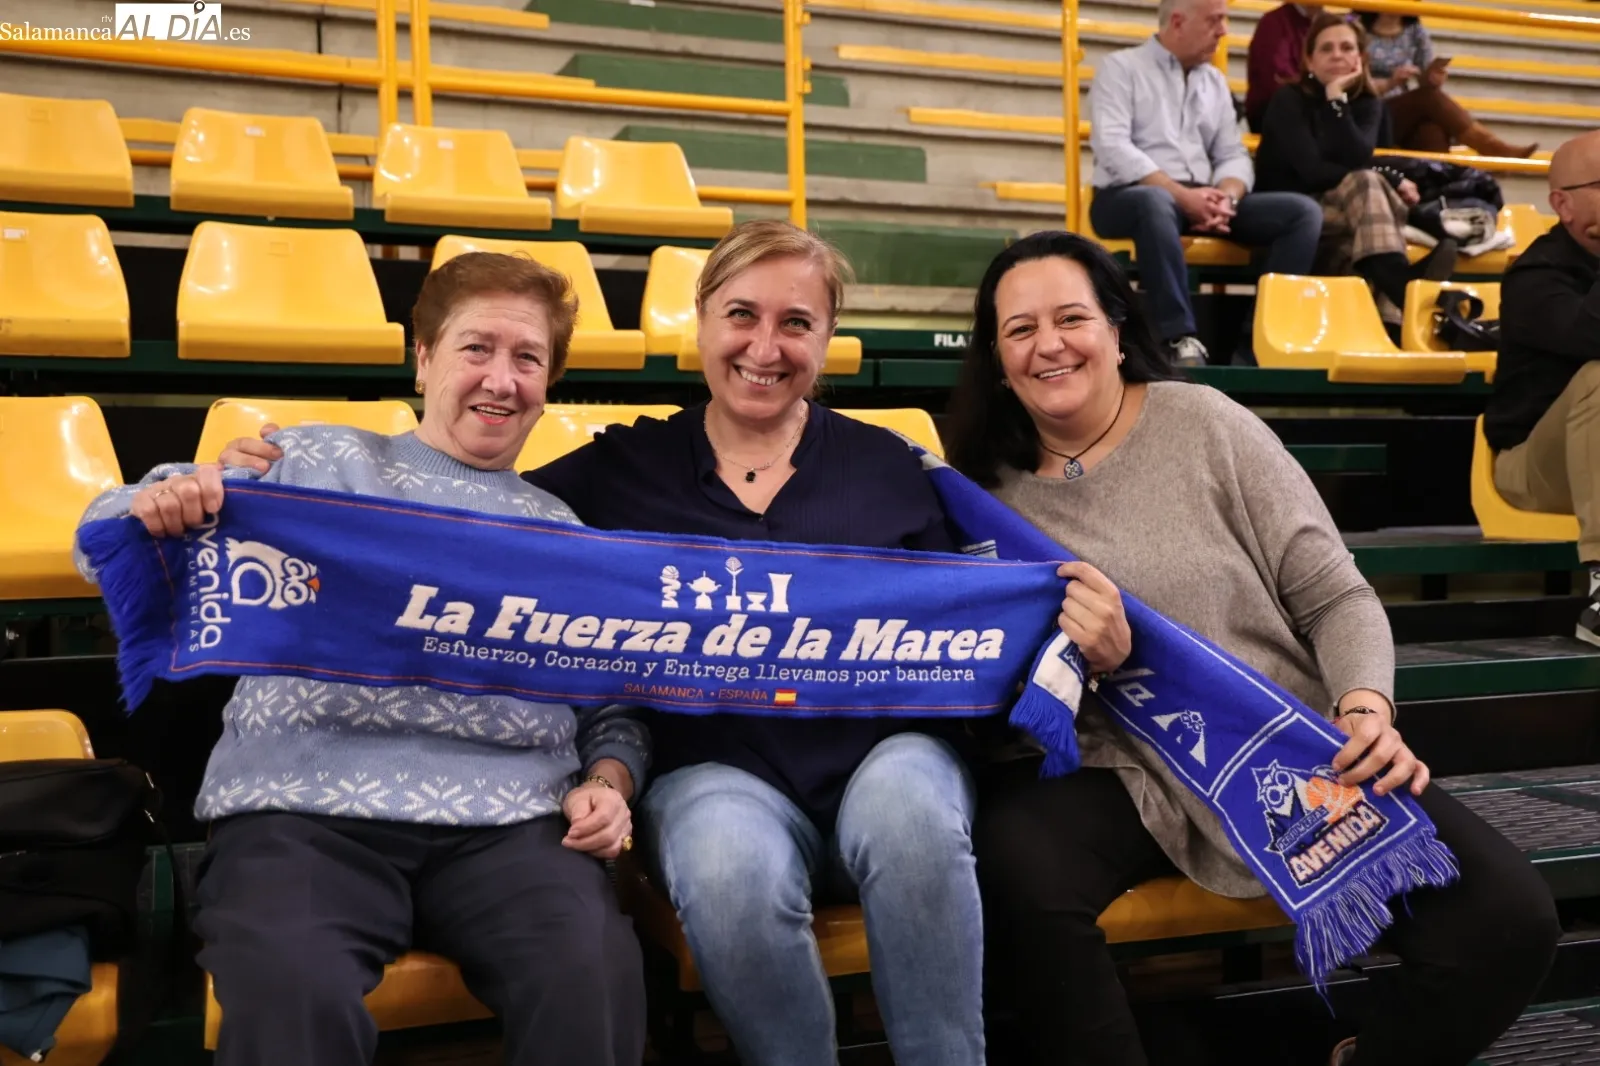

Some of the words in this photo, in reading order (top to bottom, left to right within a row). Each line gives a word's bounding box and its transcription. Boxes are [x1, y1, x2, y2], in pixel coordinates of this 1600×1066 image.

[933, 333, 967, 348] FILA
[394, 584, 475, 636] La
[483, 594, 692, 654] Fuerza
[701, 613, 773, 661] de
[777, 616, 833, 662] la
[838, 618, 1005, 662] Marea
[422, 635, 537, 669] Esfuerzo,
[543, 650, 638, 675] Corazón
[643, 659, 659, 678] y
[662, 657, 751, 683] Entrega
[754, 662, 850, 683] llevamos
[854, 667, 891, 687] por
[895, 665, 976, 682] bandera
[624, 682, 705, 699] SALAMANCA
[717, 687, 769, 701] ESPAÑA
[1288, 801, 1384, 883] AVENIDA
